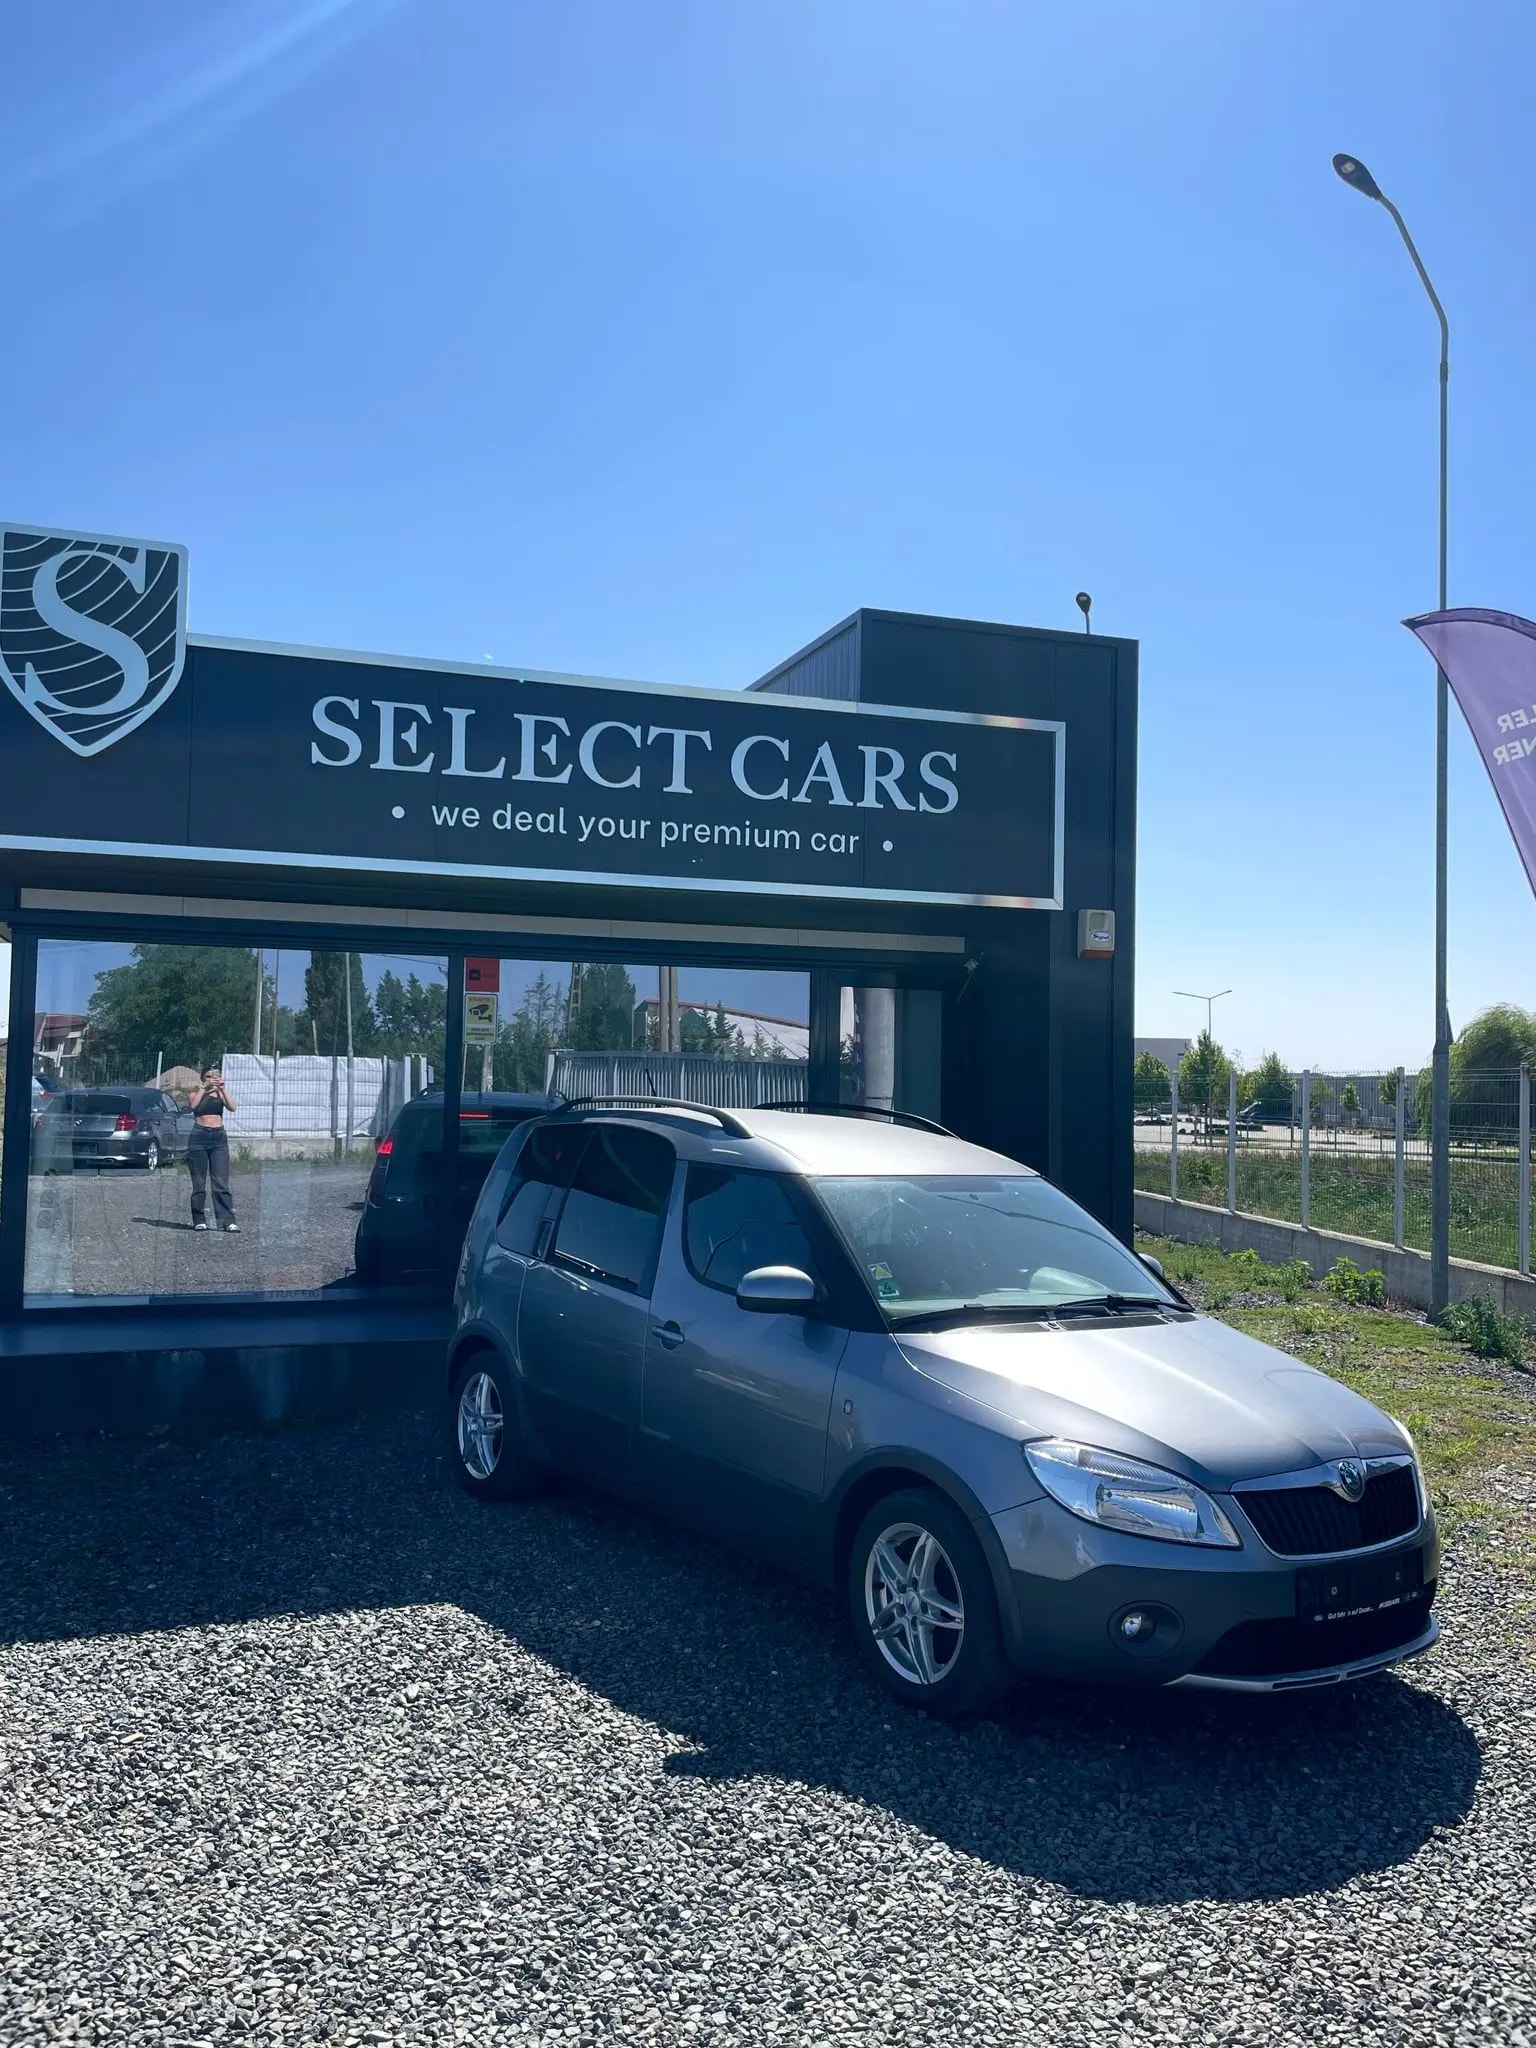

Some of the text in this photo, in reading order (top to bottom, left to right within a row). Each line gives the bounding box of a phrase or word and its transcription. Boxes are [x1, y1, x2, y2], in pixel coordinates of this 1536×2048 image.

[25, 548, 150, 716] S
[311, 695, 960, 815] SELECT CARS
[431, 802, 860, 854] we deal your premium car
